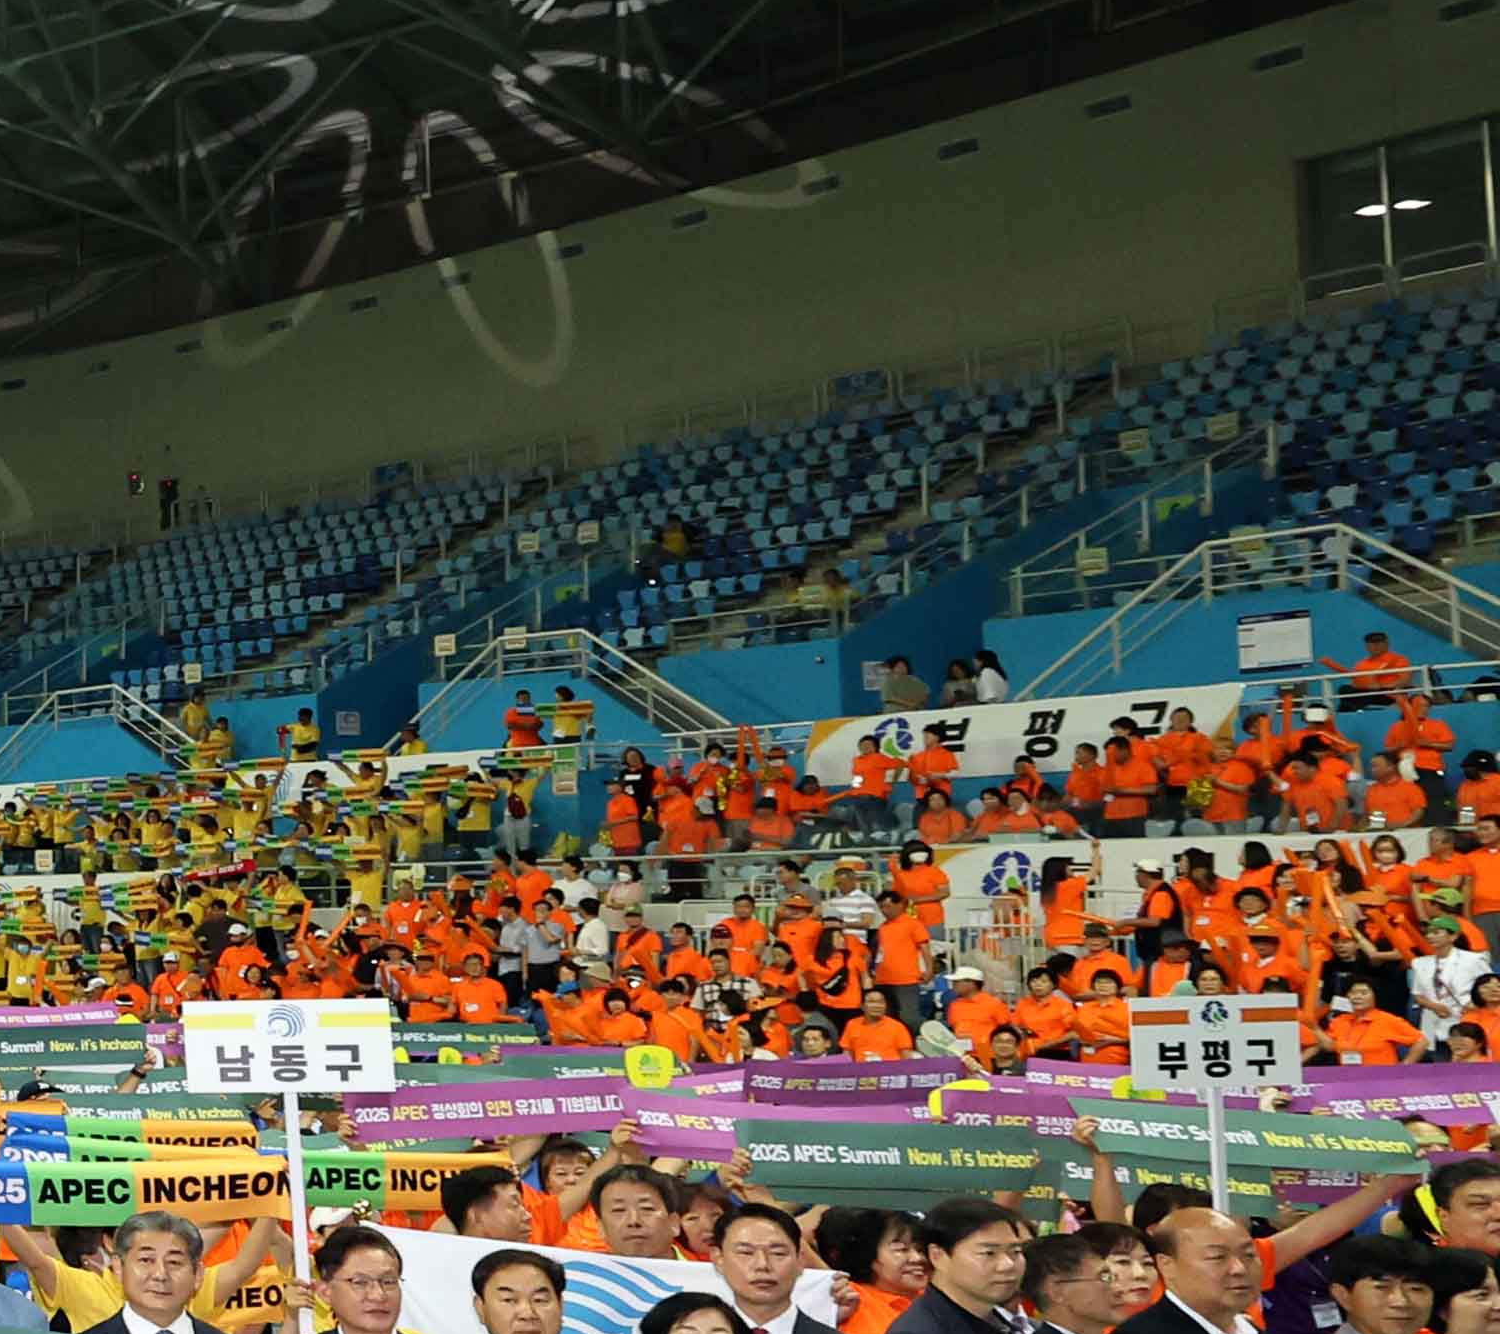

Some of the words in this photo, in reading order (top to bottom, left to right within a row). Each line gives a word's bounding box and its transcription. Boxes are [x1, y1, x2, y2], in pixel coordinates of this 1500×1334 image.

[928, 702, 1169, 759] 부평구
[216, 1044, 362, 1083] 남동구
[1158, 1039, 1276, 1078] 부평구
[355, 1106, 390, 1124] 2025
[392, 1105, 428, 1122] APEC
[431, 1103, 483, 1120] 정상회의
[486, 1102, 513, 1120] 인천
[515, 1099, 556, 1117] 유치를
[1098, 1118, 1139, 1137] 2025
[1141, 1122, 1183, 1141] APEC
[1314, 1132, 1338, 1150] it's
[1339, 1135, 1412, 1154] Incheon
[749, 1143, 791, 1162] 2025
[794, 1145, 837, 1164] APEC
[839, 1146, 901, 1165] Summit
[950, 1148, 973, 1167] it's
[38, 1176, 131, 1205] APEC
[142, 1167, 290, 1208] INCHEON
[307, 1165, 382, 1192] APEC
